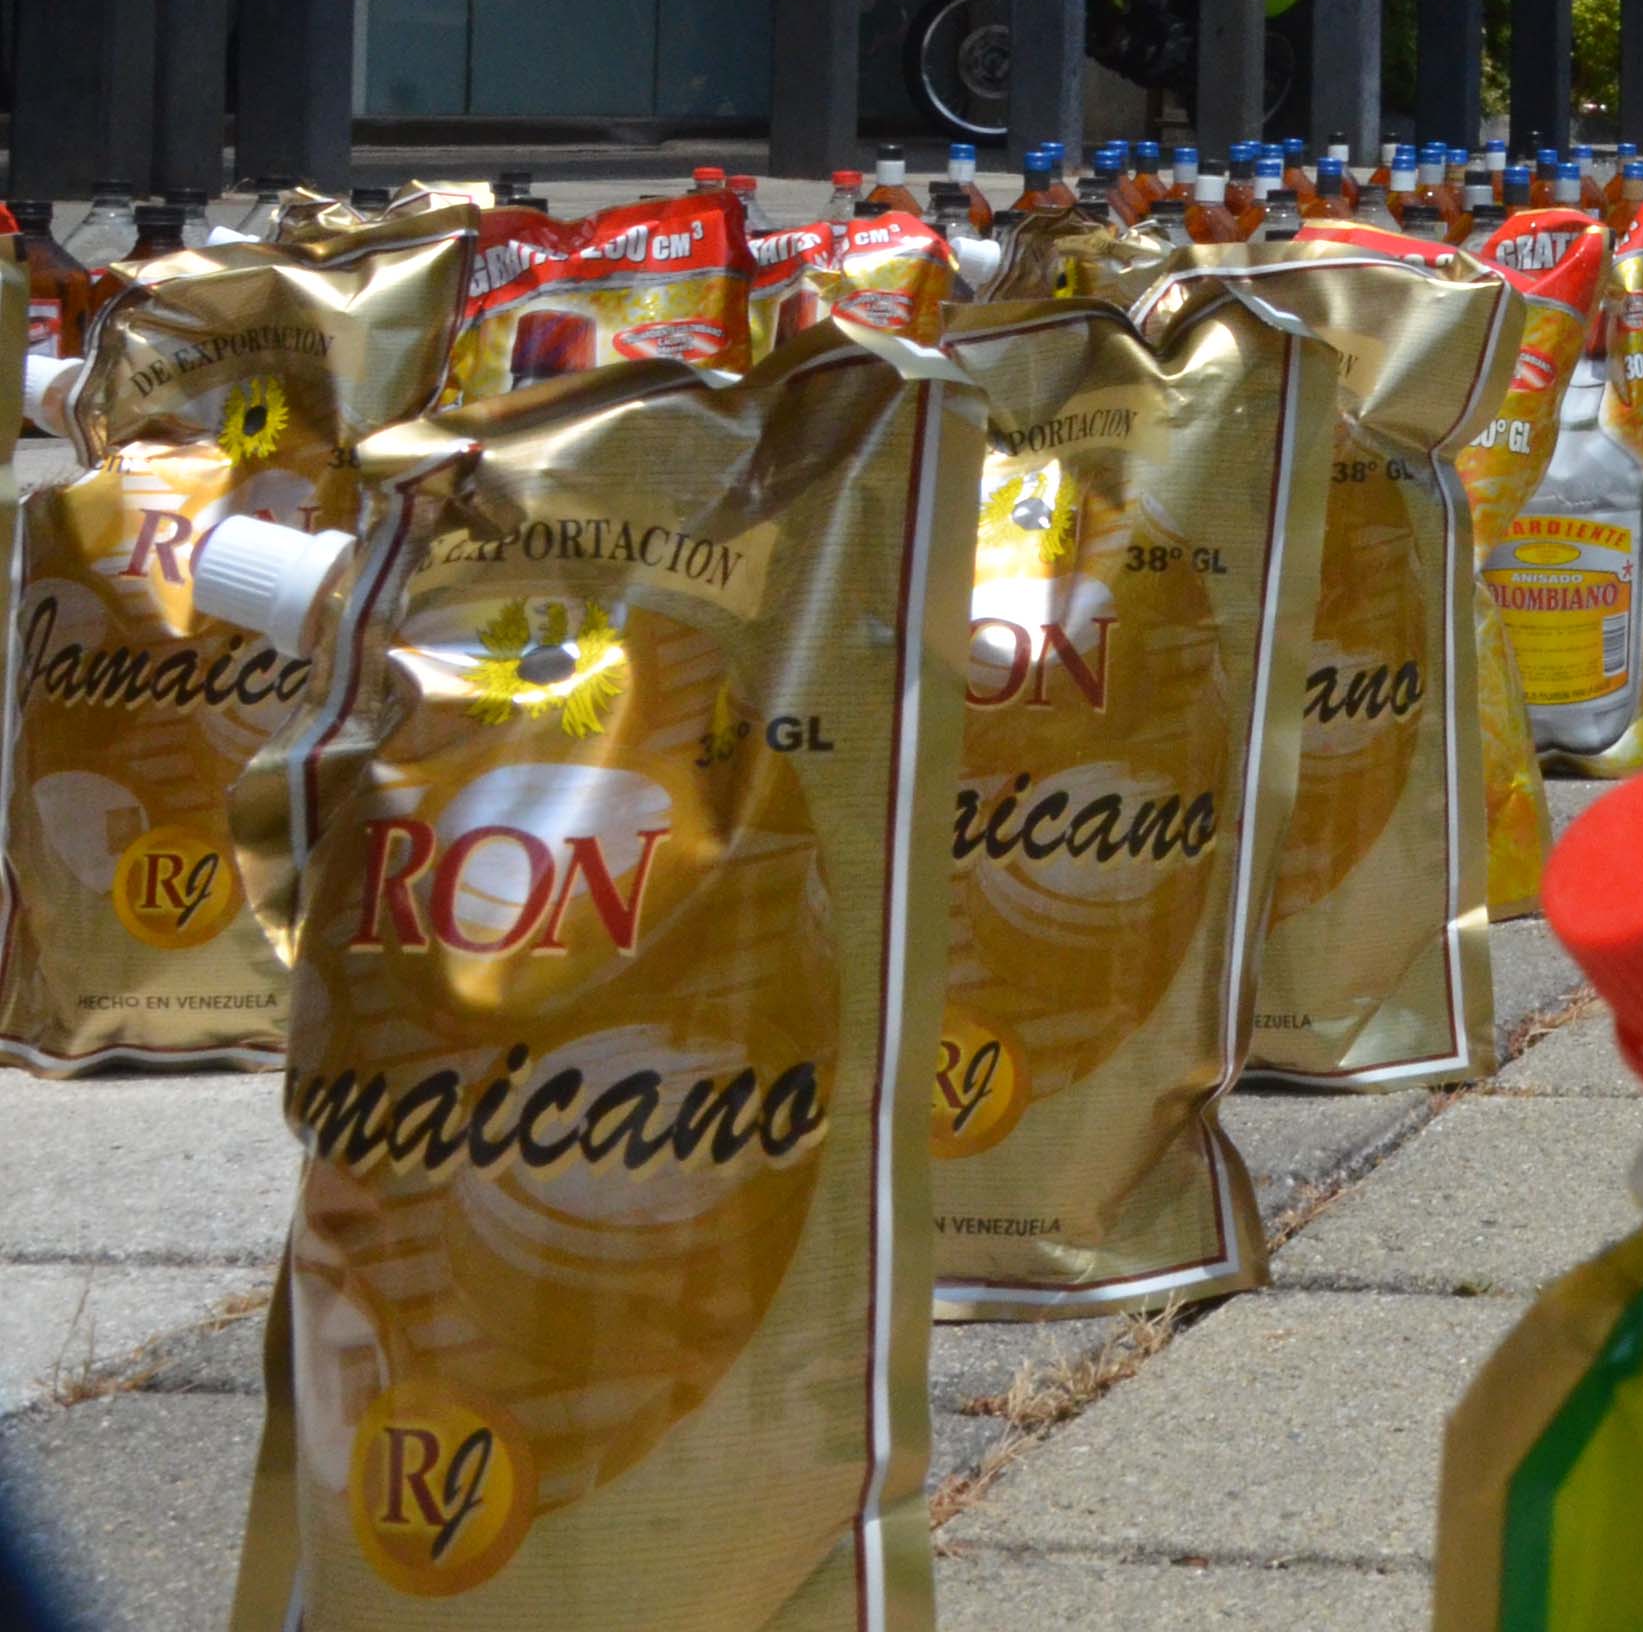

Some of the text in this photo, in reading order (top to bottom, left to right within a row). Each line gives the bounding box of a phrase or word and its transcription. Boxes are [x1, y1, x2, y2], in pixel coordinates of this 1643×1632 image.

[130, 324, 335, 399] DE EXPORTACION
[1488, 582, 1620, 612] OLOMBIANO
[765, 715, 834, 753] GL
[350, 820, 672, 958] RON
[77, 990, 279, 1012] HECHO EN VENEZUELA
[1252, 1011, 1314, 1030] EZUELA
[286, 1041, 830, 1174] maicano
[952, 1215, 1062, 1237] VENEZUELA
